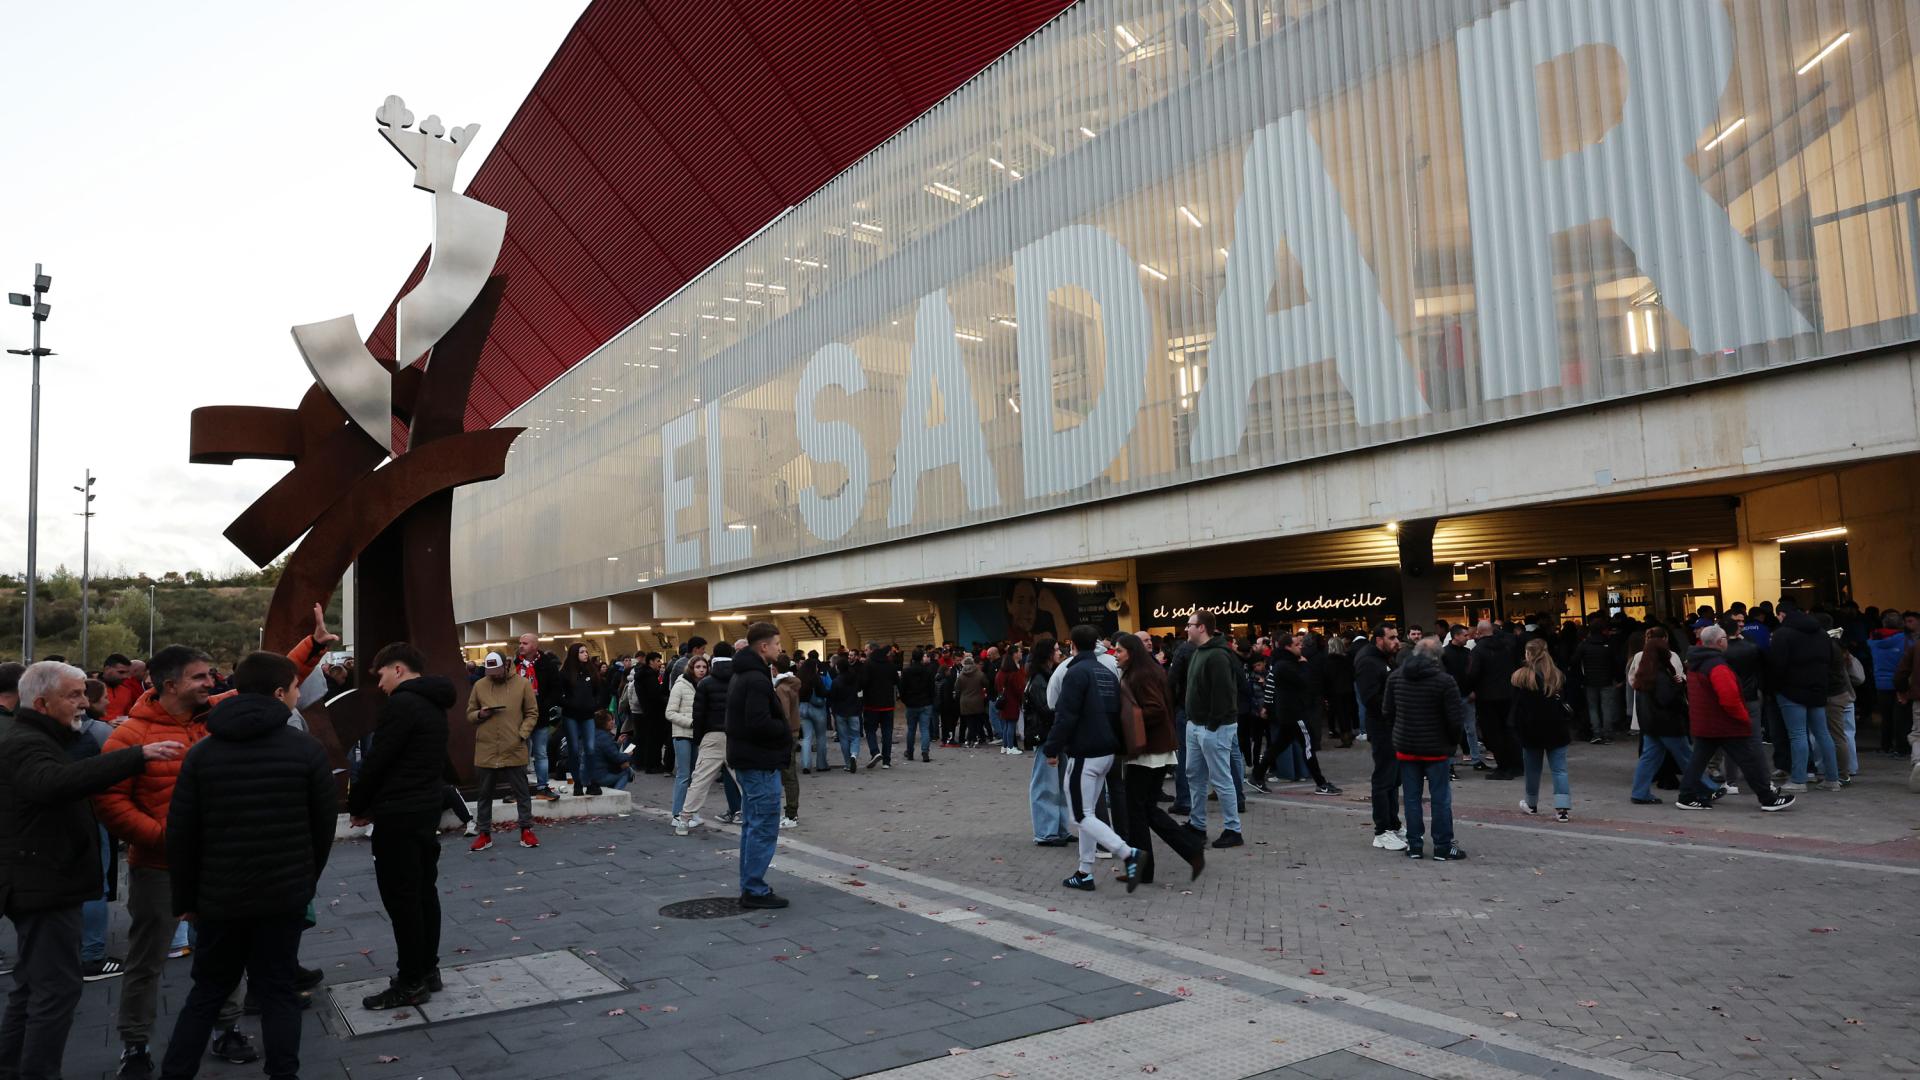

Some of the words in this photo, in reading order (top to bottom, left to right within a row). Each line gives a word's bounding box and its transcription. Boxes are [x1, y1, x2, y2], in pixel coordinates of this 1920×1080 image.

[661, 400, 752, 575] EL
[795, 0, 1814, 541] SADAR
[1153, 605, 1169, 618] el
[1275, 597, 1293, 611] el
[1296, 592, 1387, 612] sadarcillo
